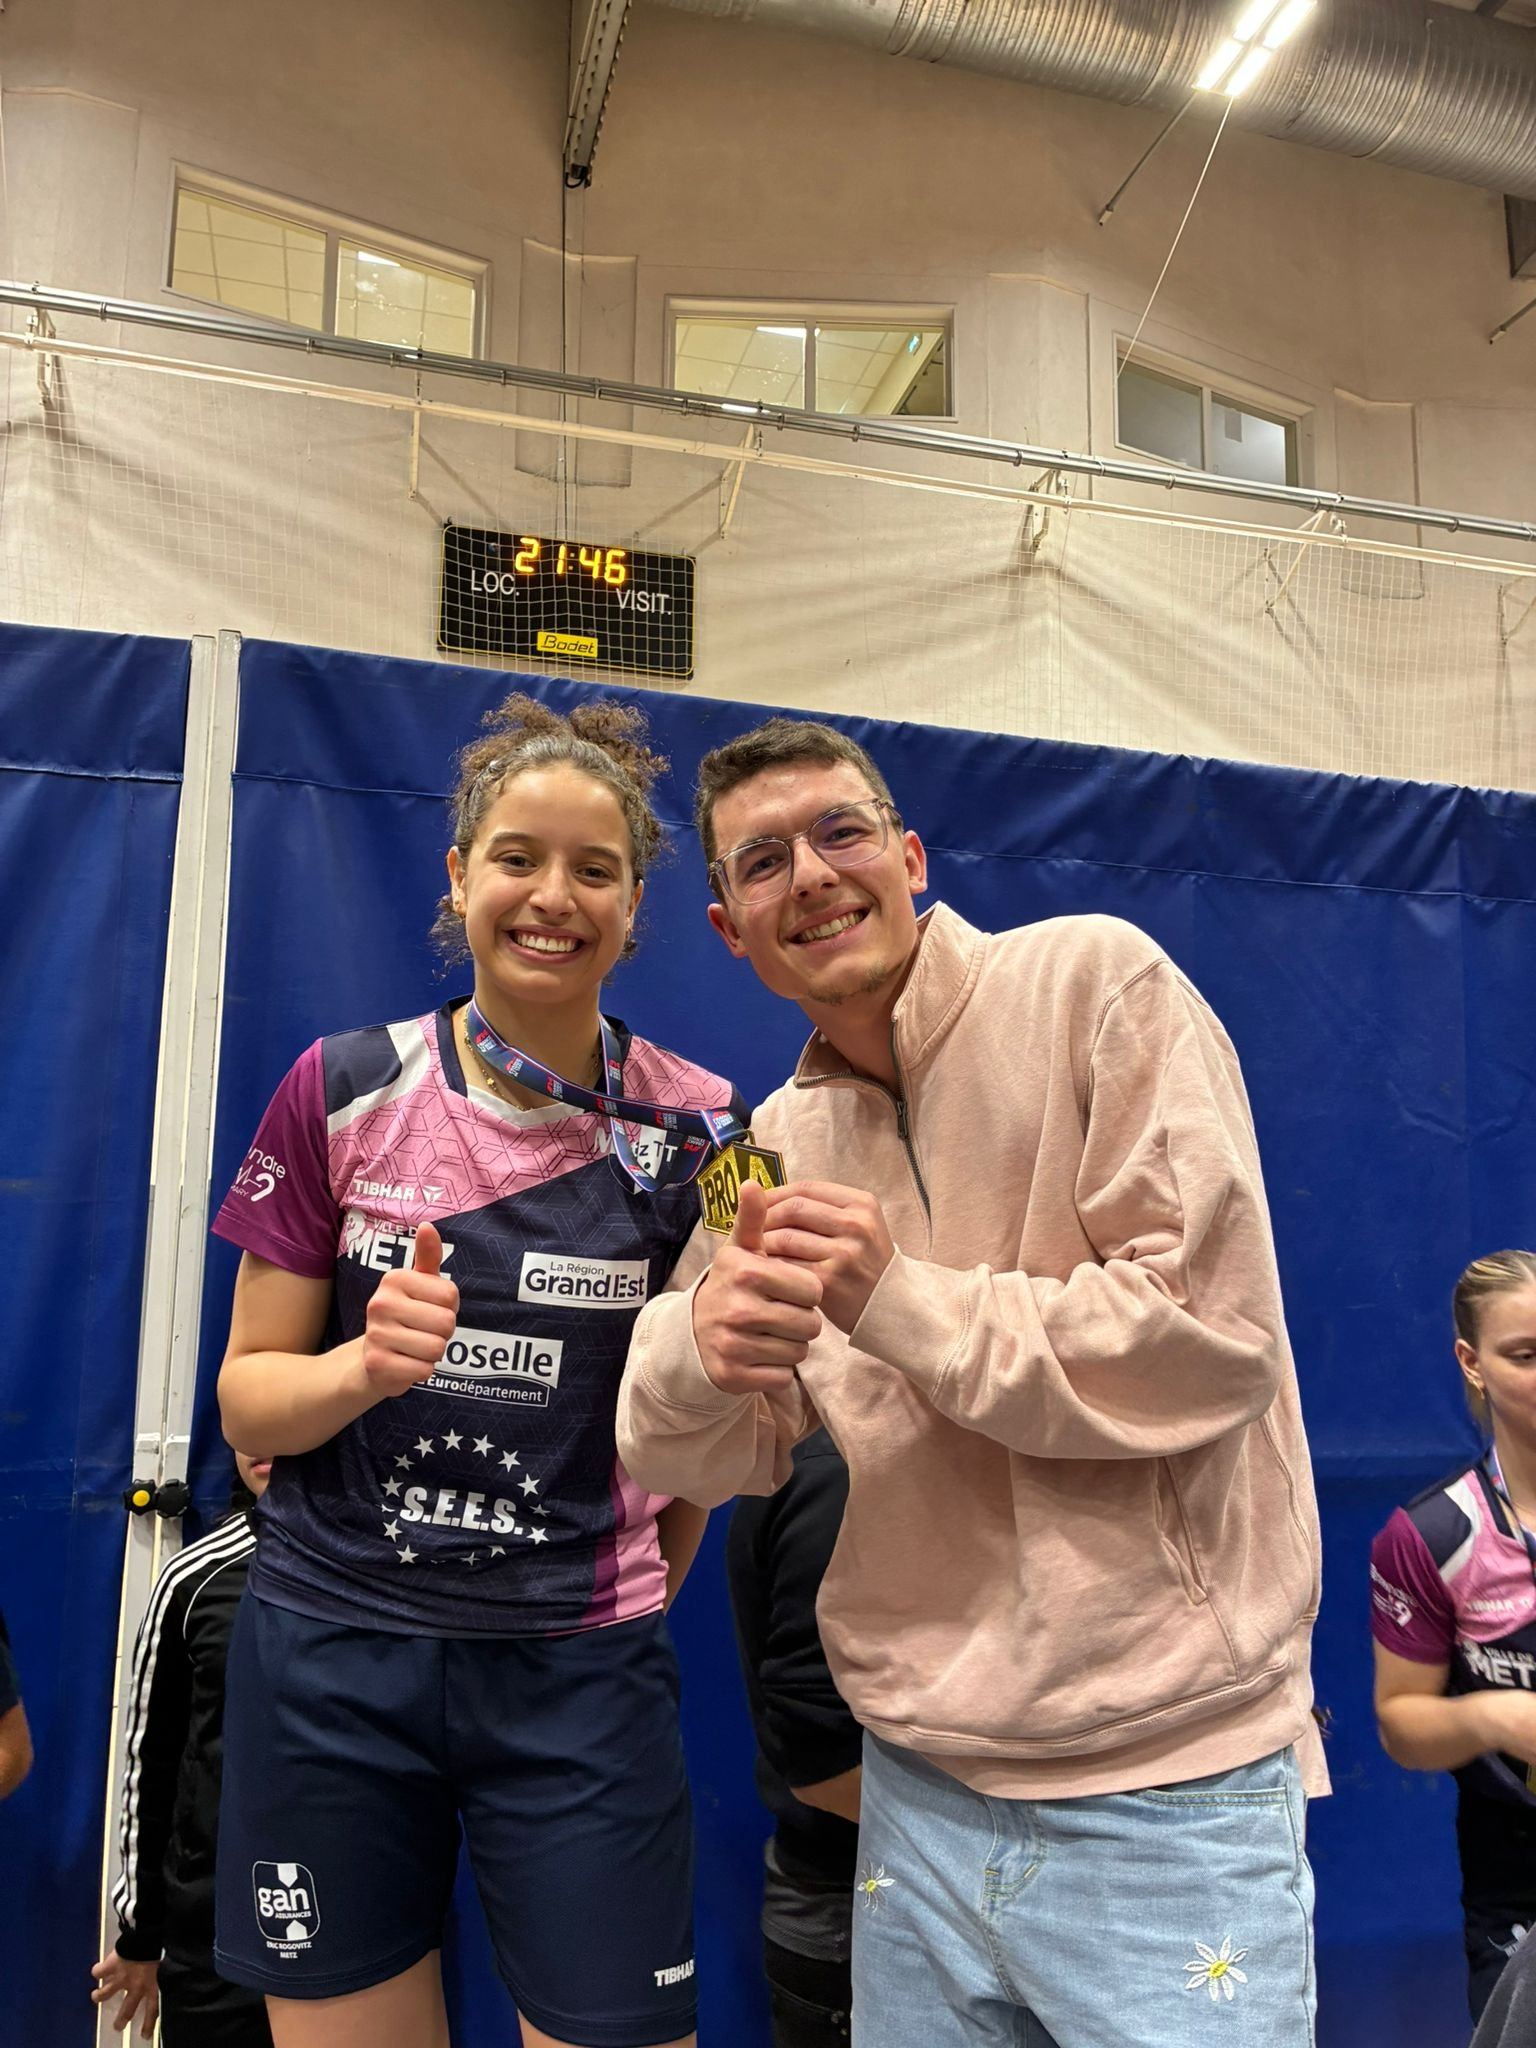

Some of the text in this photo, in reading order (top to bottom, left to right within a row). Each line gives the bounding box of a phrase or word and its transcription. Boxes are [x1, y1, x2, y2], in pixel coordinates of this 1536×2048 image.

[471, 570, 520, 596] LOC.
[616, 588, 672, 615] VISIT.
[541, 634, 595, 654] Bodet
[353, 1180, 415, 1201] TIBHAR
[703, 1160, 739, 1221] PRO
[374, 1218, 404, 1236] VILLE
[550, 1261, 605, 1276] La Région
[446, 1340, 553, 1377] oselle
[399, 1486, 523, 1535] S.E.E.S.
[1464, 1654, 1536, 1689] MET
[258, 1887, 310, 1917] gan
[274, 1910, 312, 1919] ASSURANCES
